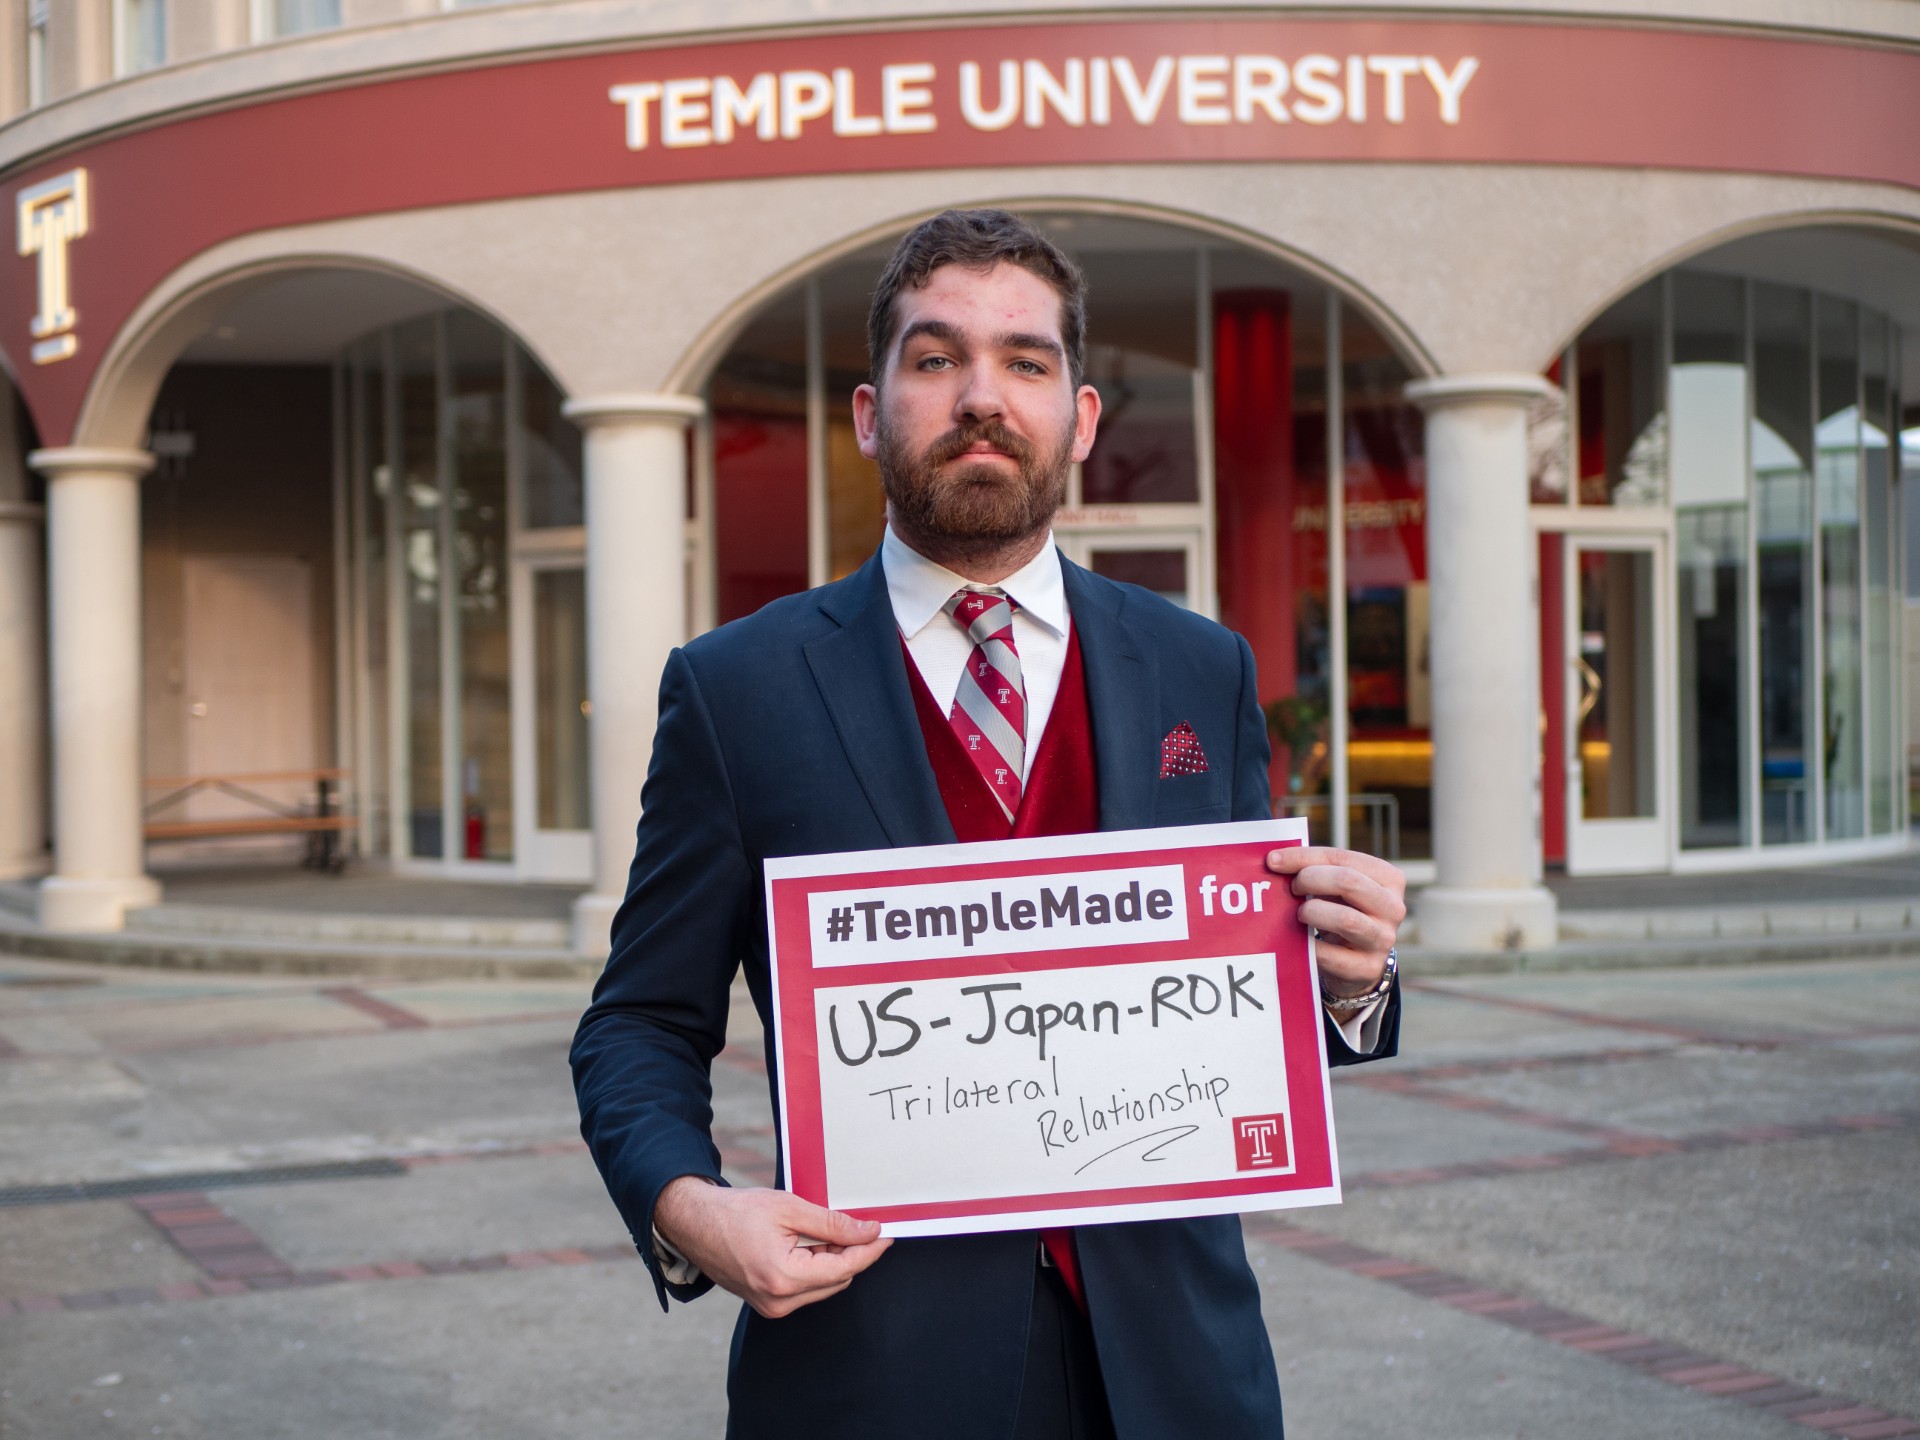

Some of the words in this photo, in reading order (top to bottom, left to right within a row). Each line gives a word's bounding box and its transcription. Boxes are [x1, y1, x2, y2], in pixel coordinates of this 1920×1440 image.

[609, 63, 938, 150] TEMPLE
[958, 54, 1480, 131] UNIVERSITY
[17, 167, 89, 366] T
[826, 880, 1174, 947] #TempleMade
[1199, 874, 1273, 917] for
[829, 964, 1266, 1068] US-Japan-ROK
[868, 1056, 1060, 1121] Trilateral
[1037, 1065, 1230, 1156] Relationship
[1240, 1118, 1279, 1165] T
